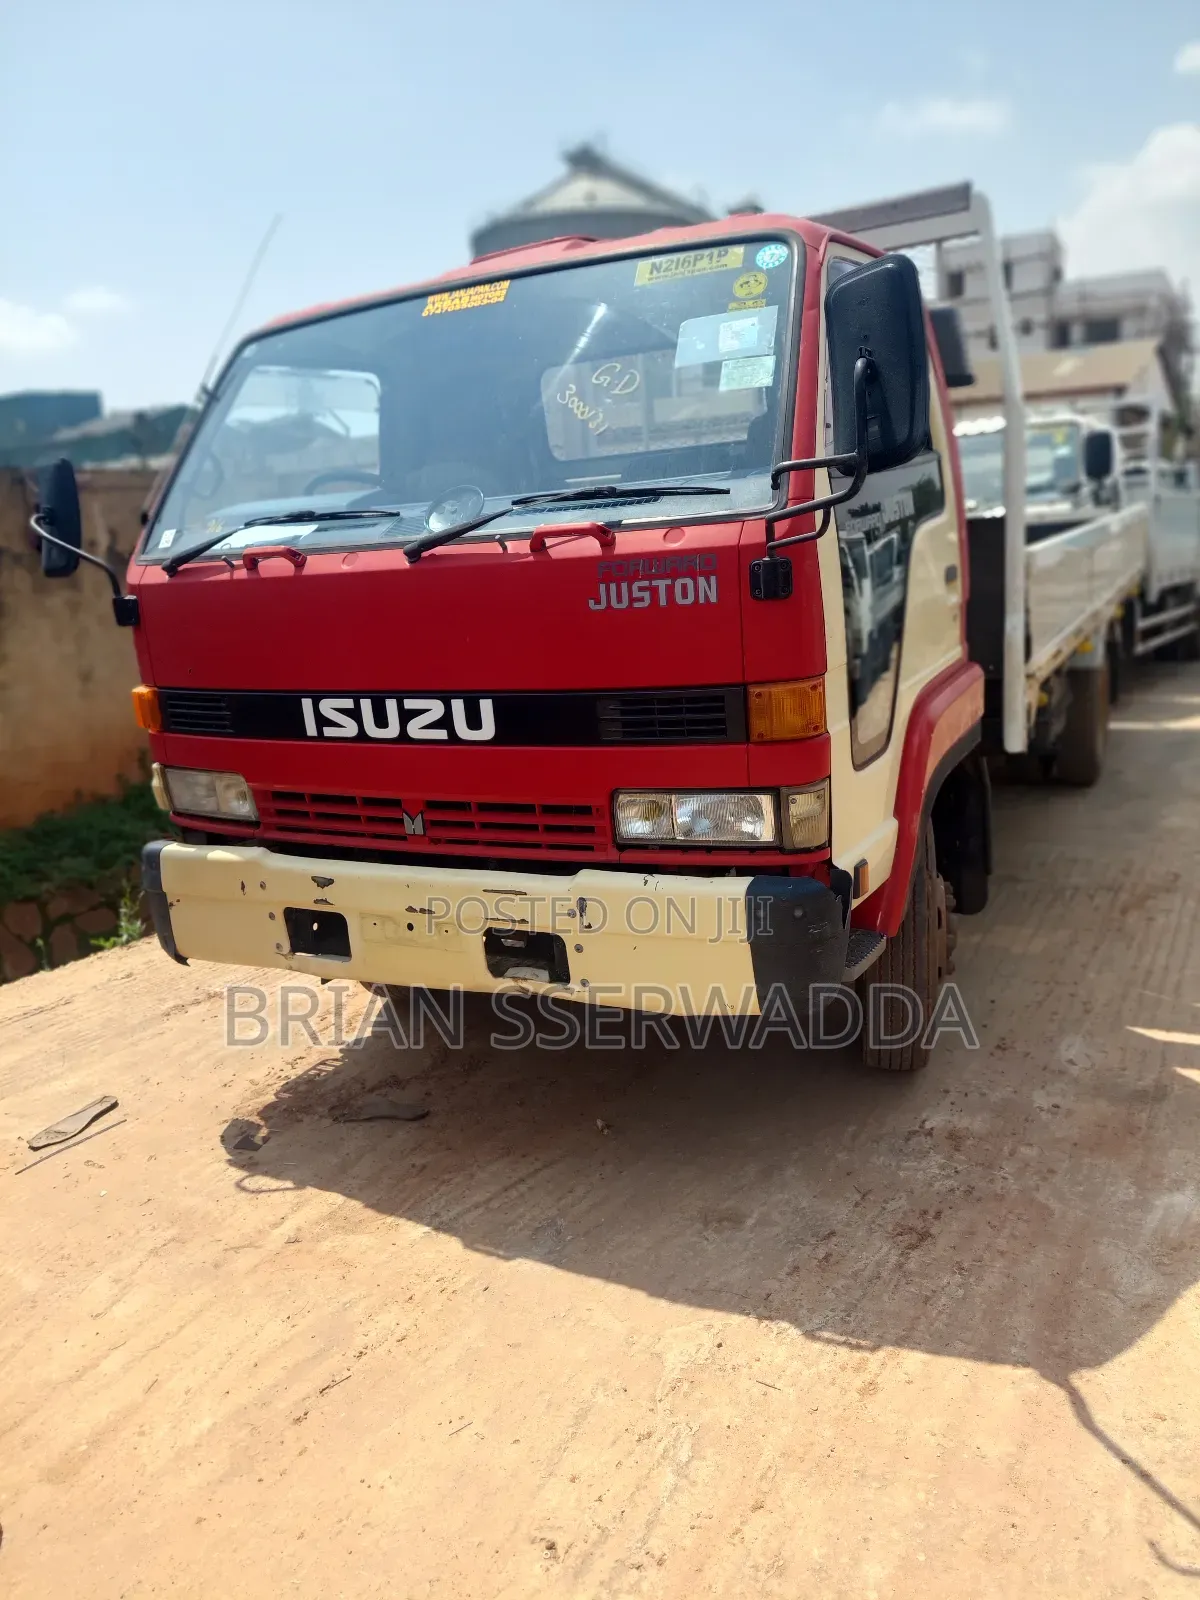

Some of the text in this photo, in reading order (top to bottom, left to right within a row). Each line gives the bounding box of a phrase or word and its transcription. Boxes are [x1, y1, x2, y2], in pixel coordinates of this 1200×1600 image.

[597, 553, 717, 578] FORWARD
[588, 575, 718, 611] JUSTON
[301, 697, 496, 741] ISUZU
